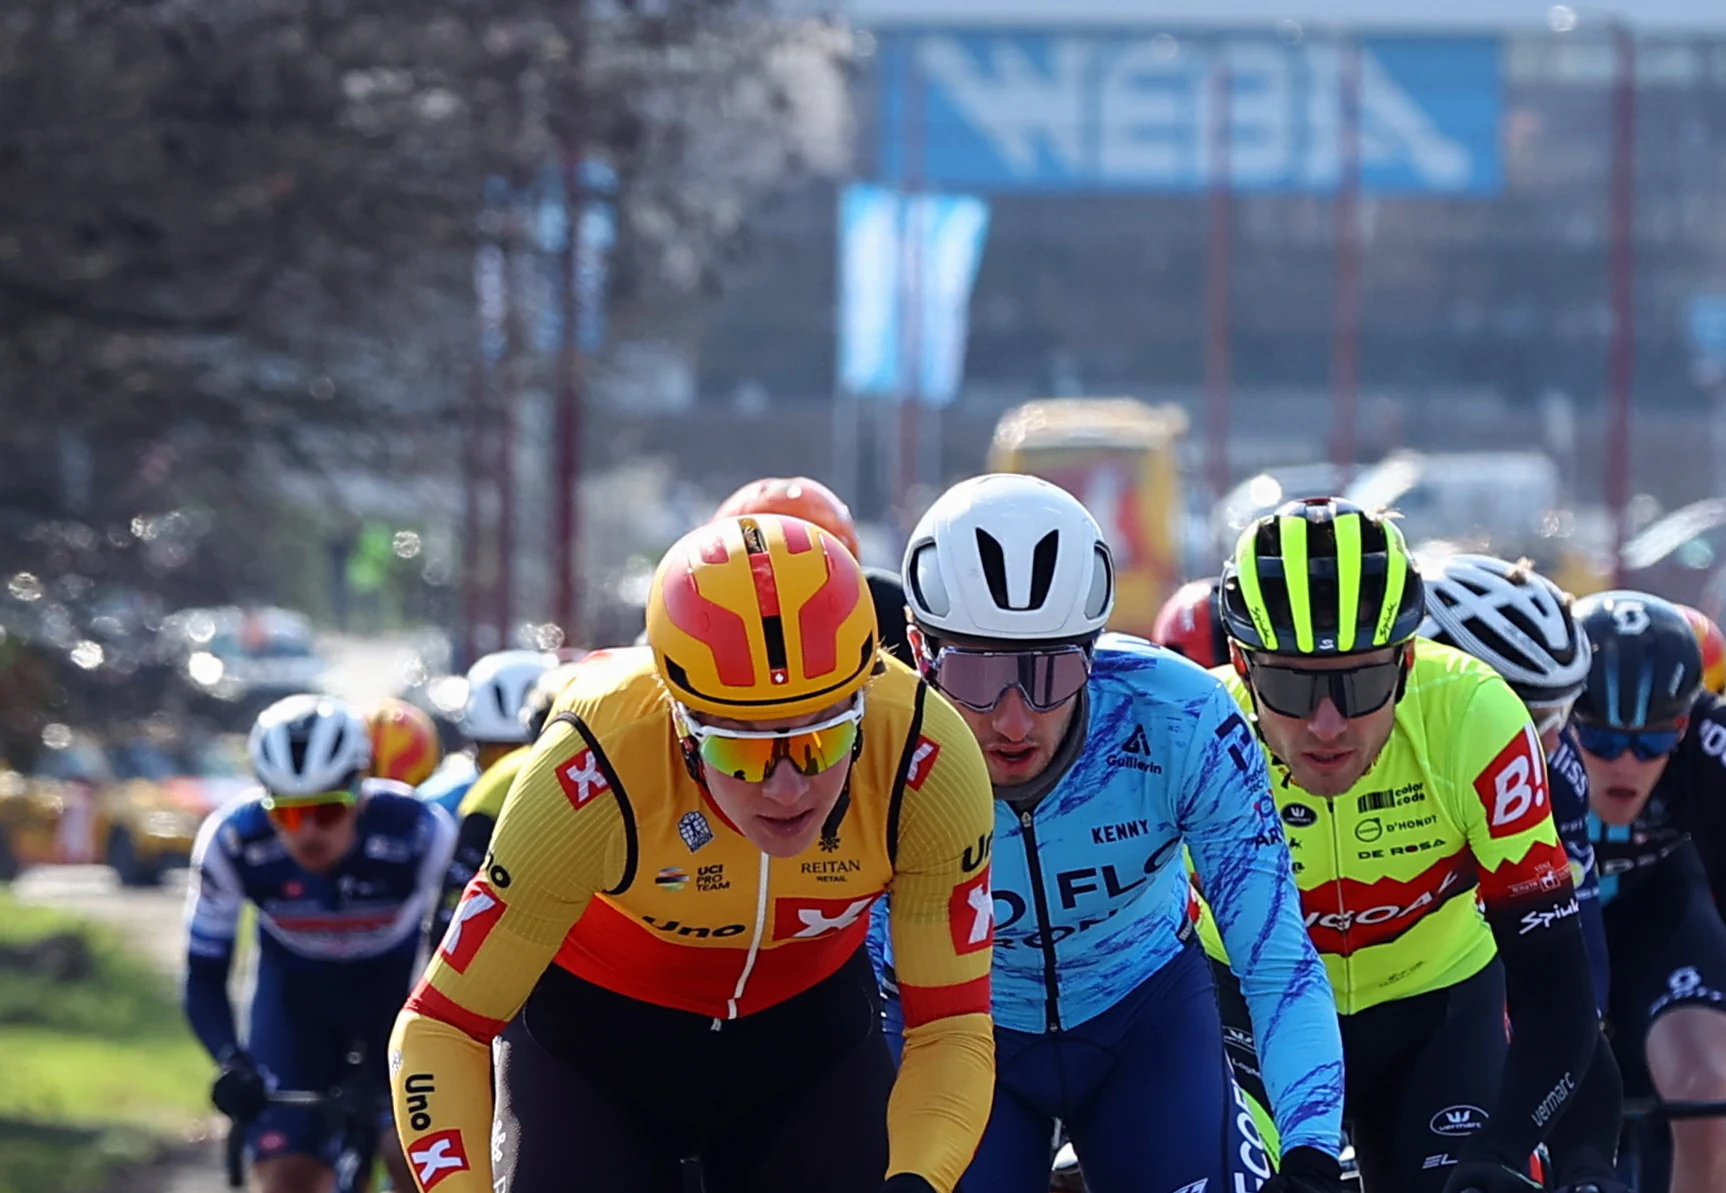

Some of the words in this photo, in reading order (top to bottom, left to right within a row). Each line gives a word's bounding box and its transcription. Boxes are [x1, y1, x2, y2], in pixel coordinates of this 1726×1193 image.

[916, 33, 1474, 190] WEBA
[1491, 722, 1542, 827] B!
[1395, 783, 1424, 797] color
[1397, 791, 1426, 806] code
[1386, 814, 1438, 832] D'HONDT
[1090, 819, 1151, 844] KENNY
[1358, 850, 1384, 860] DE
[1390, 838, 1447, 856] ROSA
[697, 864, 723, 876] UCI
[801, 859, 861, 873] REITAN
[696, 874, 723, 884] PRO
[696, 880, 730, 892] TEAM
[816, 875, 847, 883] RETAIL
[641, 915, 746, 938] Uno
[404, 1073, 435, 1131] Uno
[1531, 1071, 1575, 1127] vermarc
[1438, 1121, 1482, 1131] vermarc
